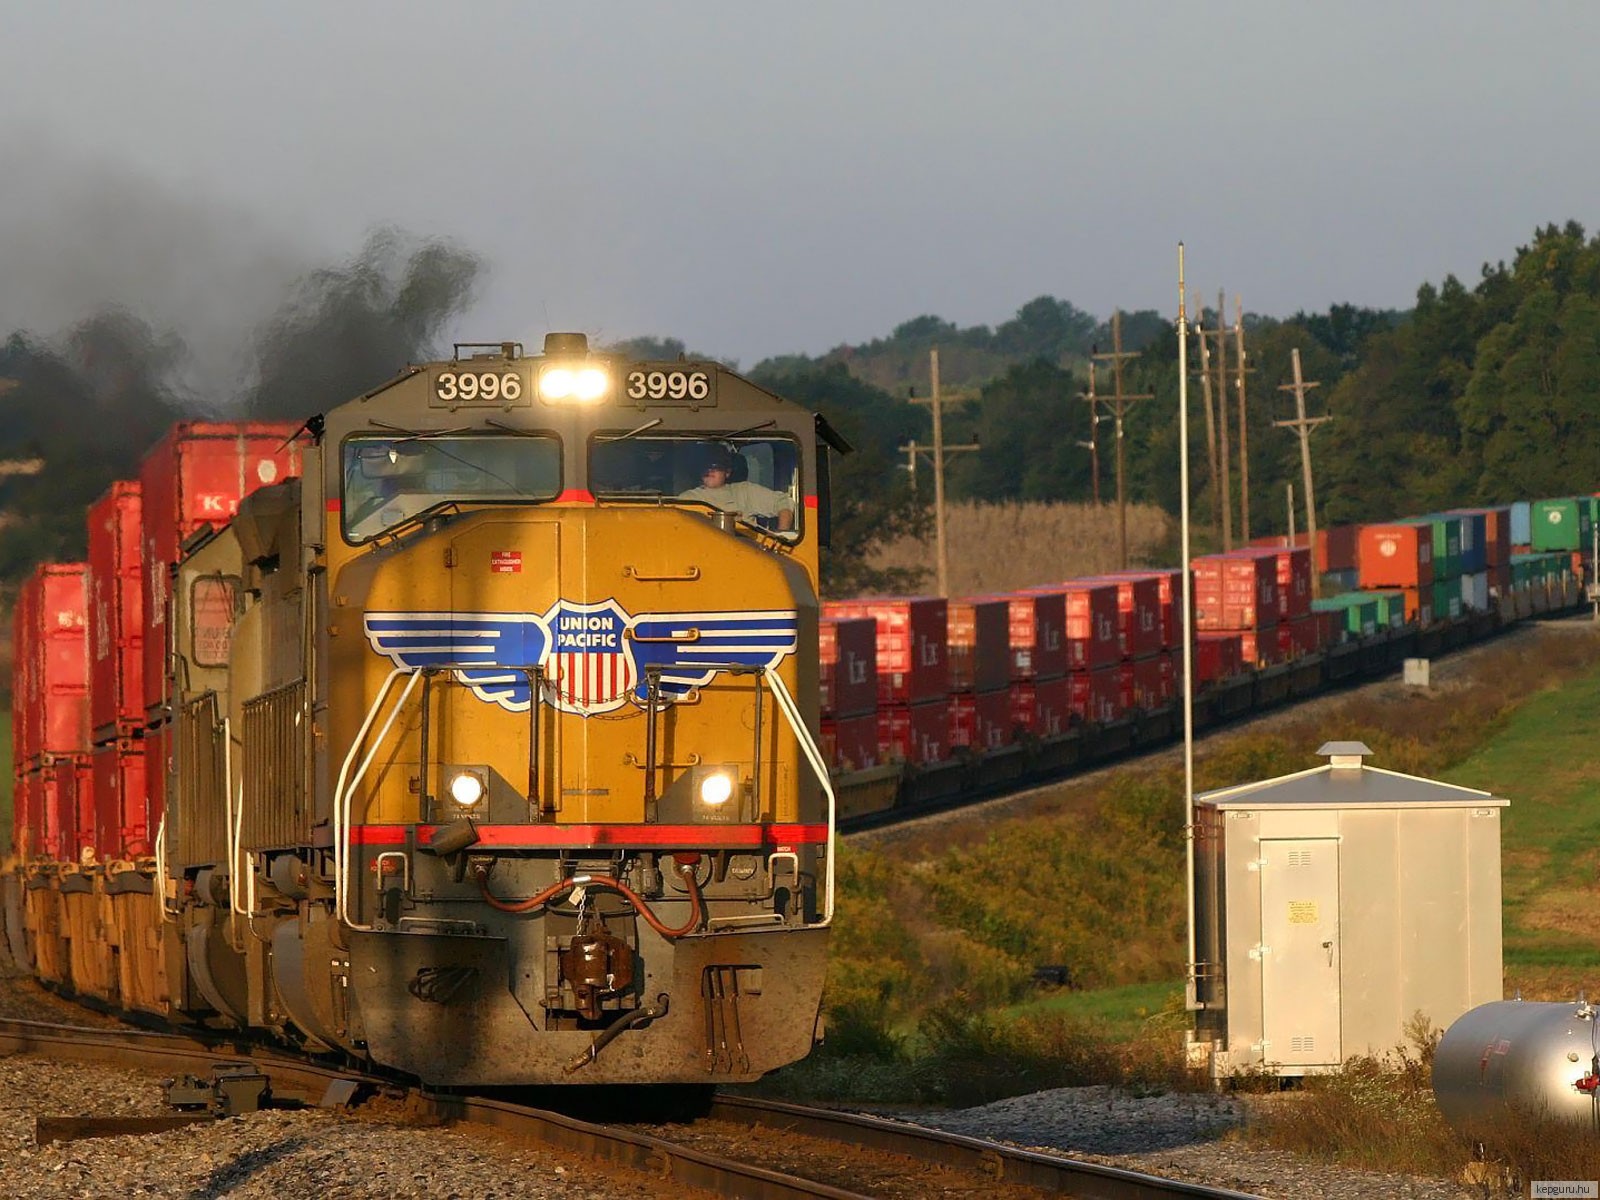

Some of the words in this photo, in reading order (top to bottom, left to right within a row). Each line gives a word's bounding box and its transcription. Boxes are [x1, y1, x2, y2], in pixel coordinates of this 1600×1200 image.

[437, 373, 521, 400] 3996
[627, 372, 708, 400] 3996
[559, 617, 613, 630] UNION
[557, 633, 617, 647] PACIFIC
